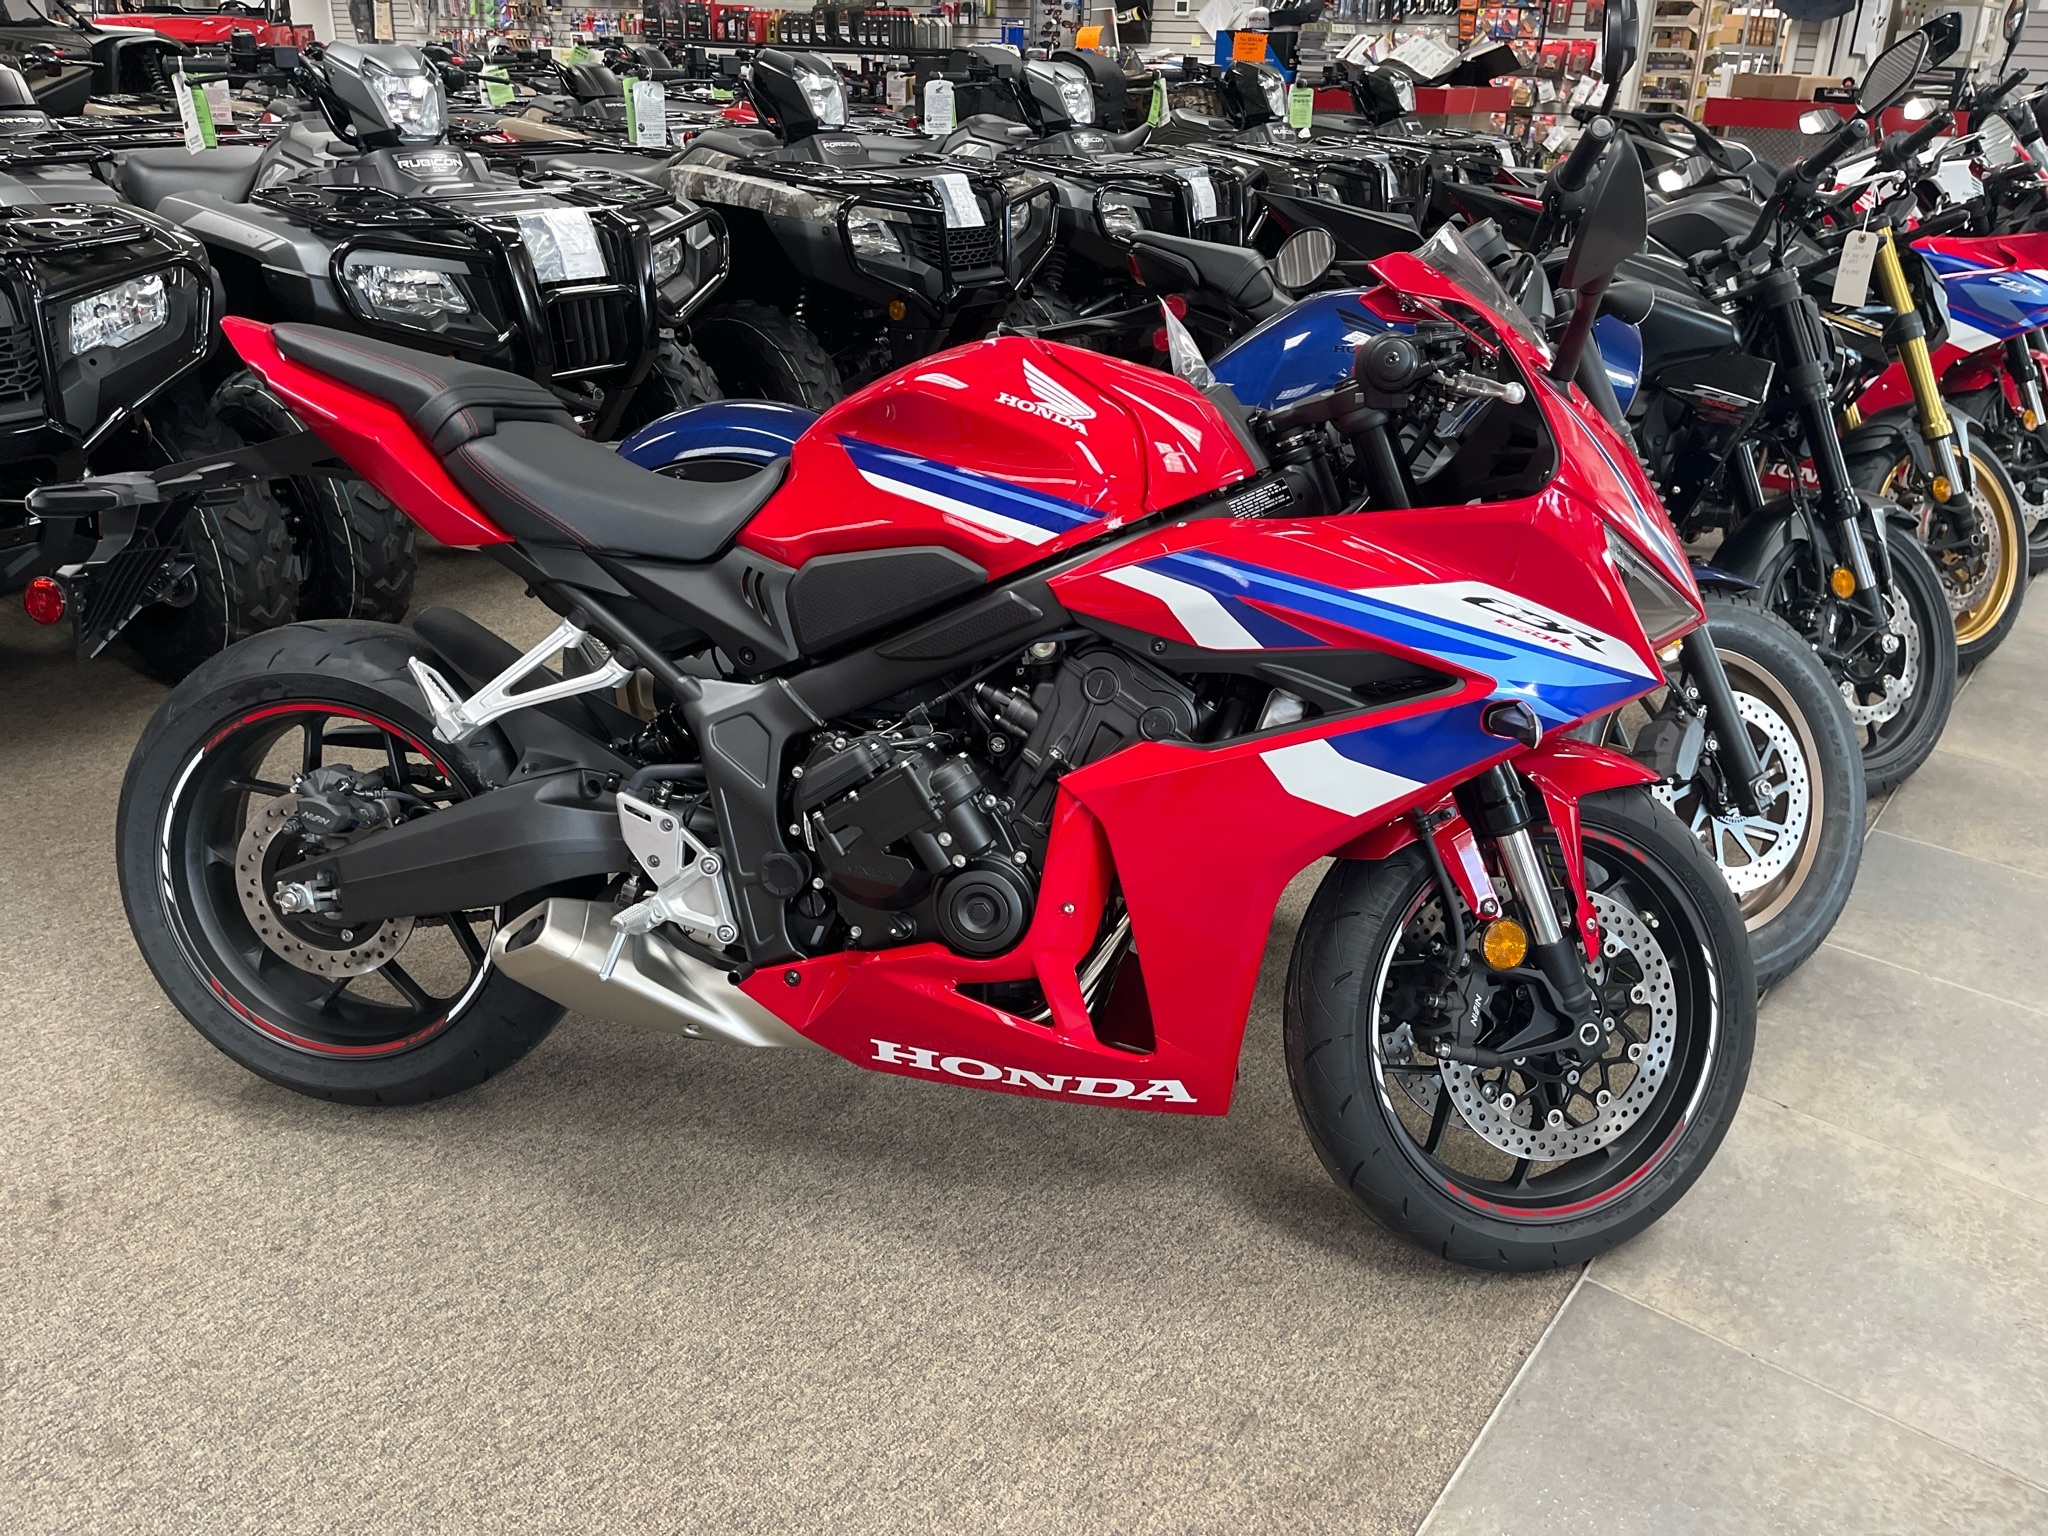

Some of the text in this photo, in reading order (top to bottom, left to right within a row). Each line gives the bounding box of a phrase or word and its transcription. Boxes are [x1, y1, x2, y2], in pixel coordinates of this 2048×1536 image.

[397, 158, 463, 169] RUBICON
[823, 141, 861, 149] FOREMAN
[994, 391, 1089, 437] HONDA
[1461, 596, 1608, 656] CBR
[870, 1038, 1198, 1103] HONDA
